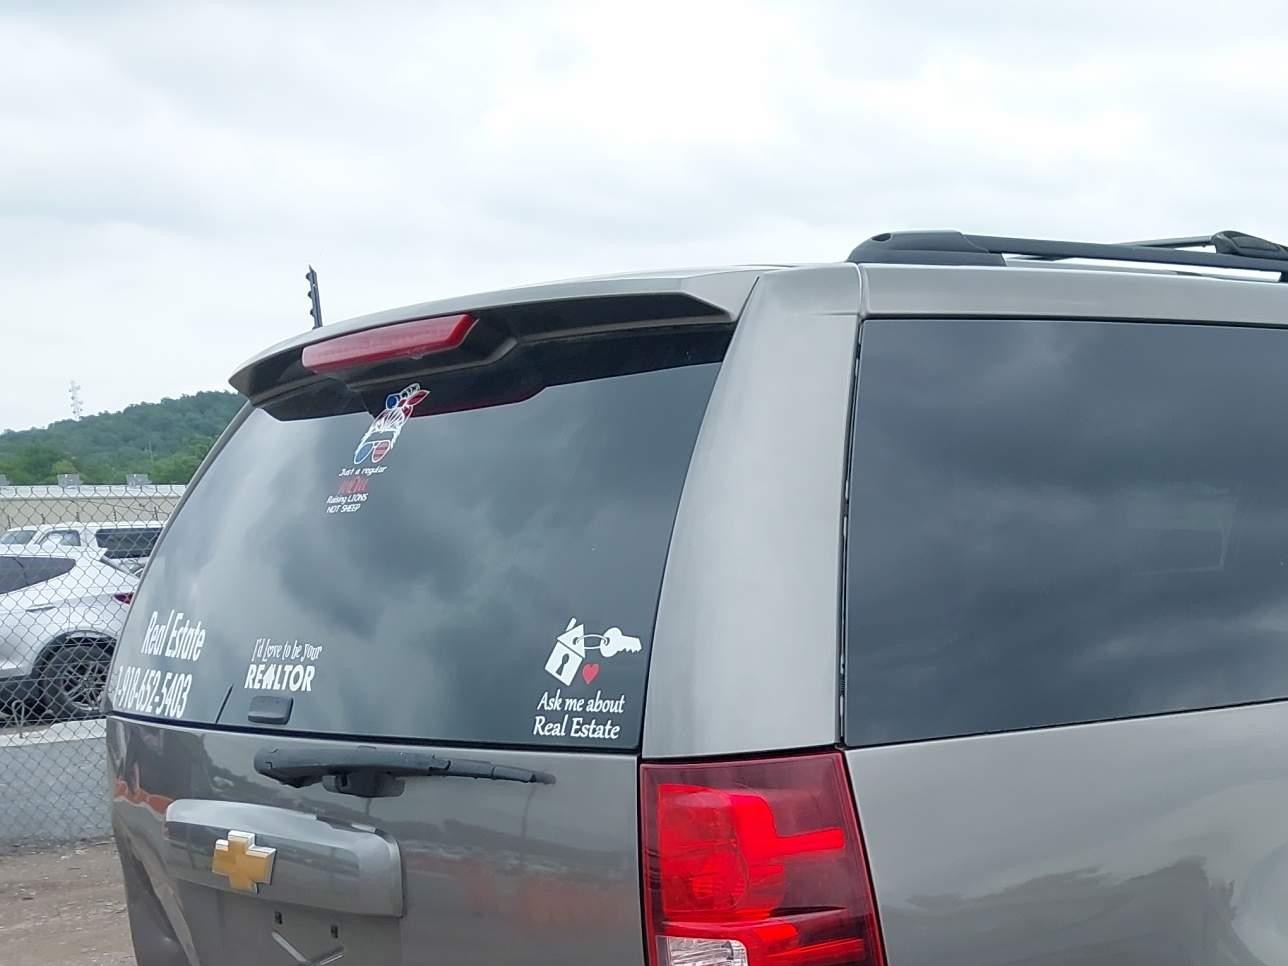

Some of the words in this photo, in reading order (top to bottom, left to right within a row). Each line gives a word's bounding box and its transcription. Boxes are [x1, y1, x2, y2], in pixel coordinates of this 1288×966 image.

[140, 608, 175, 656] Real
[164, 612, 206, 662] Estate
[243, 663, 315, 692] REALTOR
[536, 688, 562, 711] Ask
[564, 698, 584, 712] me
[585, 690, 625, 713] about
[533, 714, 569, 736] Real
[570, 717, 620, 739] Estate
